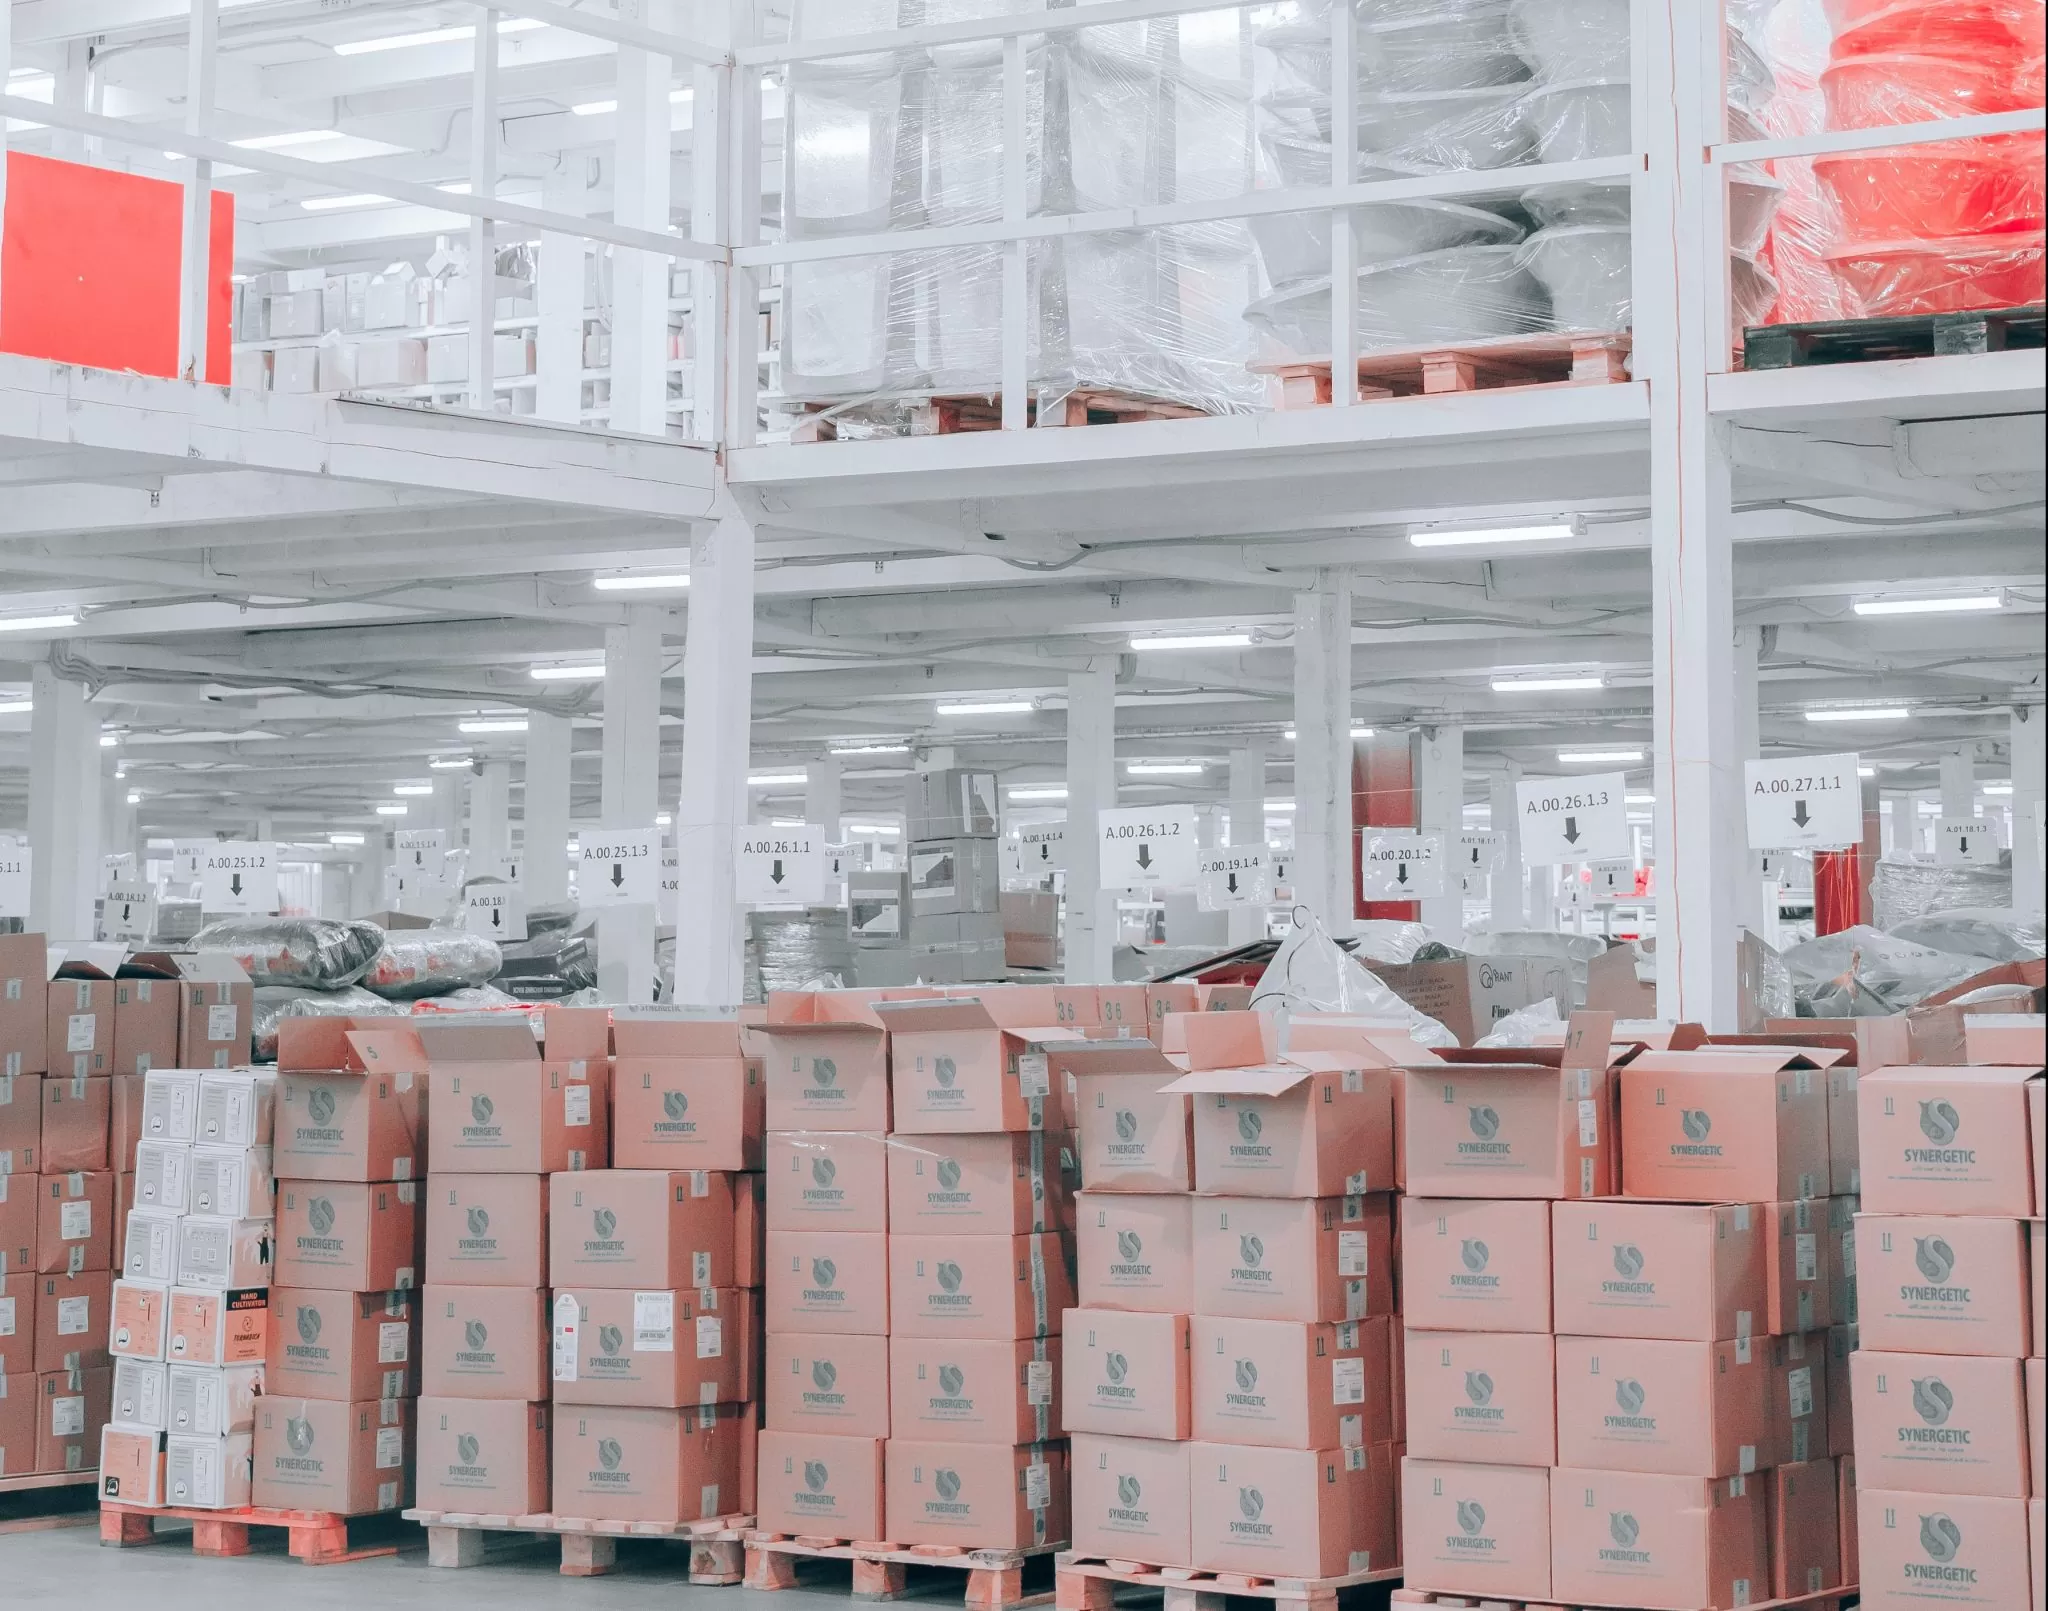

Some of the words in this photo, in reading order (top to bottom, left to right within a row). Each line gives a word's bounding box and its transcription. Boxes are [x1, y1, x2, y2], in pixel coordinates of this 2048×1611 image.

[1754, 776, 1841, 794] A.00.27.1.1
[1527, 791, 1608, 814] A.00.26.1.3
[1106, 822, 1180, 839] A.00.26.1.2
[1023, 831, 1063, 844] A.00.14.1.4
[584, 845, 648, 860] A.00.25.1.3
[744, 841, 810, 853] A.00.26.1.1
[1369, 849, 1431, 861] A.00.20.1.2
[208, 857, 265, 869] A.00.25.1.2
[1201, 857, 1258, 873] A.00.19.1.4
[803, 1089, 846, 1099] SYNERGETIC
[927, 1090, 965, 1099] SYNERGETIC
[462, 1127, 502, 1137] SYNERGETIC
[653, 1122, 697, 1132] SYNERGETIC
[296, 1128, 344, 1141] SYNERGETIC
[1107, 1144, 1145, 1154] SYNERGETIC
[1230, 1146, 1272, 1156] SYNERGETIC
[1458, 1143, 1511, 1154] SYNERGETIC
[1670, 1145, 1723, 1156] SYNERGETIC
[1904, 1149, 1976, 1163] SYNERGETIC
[802, 1191, 845, 1200] SYNERGETIC
[927, 1193, 971, 1203] SYNERGETIC
[297, 1237, 344, 1251] SYNERGETIC
[458, 1239, 497, 1249] SYNERGETIC
[584, 1241, 624, 1251] SYNERGETIC
[1110, 1264, 1152, 1275] SYNERGETIC
[1231, 1269, 1272, 1281] SYNERGETIC
[1450, 1275, 1500, 1287] SYNERGETIC
[1602, 1281, 1655, 1294] SYNERGETIC
[241, 1292, 258, 1300] HAND
[803, 1290, 845, 1301] SYNERGETIC
[928, 1295, 972, 1305] SYNERGETIC
[1900, 1286, 1971, 1302] SYNERGETIC
[286, 1345, 329, 1359] SYNERGETIC
[456, 1352, 495, 1362] SYNERGETIC
[589, 1358, 631, 1368] SYNERGETIC
[1097, 1385, 1136, 1398] SYNERGETIC
[803, 1393, 845, 1404] SYNERGETIC
[929, 1399, 973, 1409] SYNERGETIC
[1226, 1393, 1266, 1406] SYNERGETIC
[1454, 1407, 1504, 1420] SYNERGETIC
[1604, 1416, 1656, 1429] SYNERGETIC
[1898, 1428, 1971, 1444] SYNERGETIC
[275, 1457, 324, 1472] SYNERGETIC
[448, 1465, 487, 1477] SYNERGETIC
[588, 1472, 631, 1482] SYNERGETIC
[794, 1493, 836, 1506] SYNERGETIC
[925, 1503, 970, 1514] SYNERGETIC
[1108, 1508, 1148, 1522] SYNERGETIC
[1230, 1522, 1273, 1535] SYNERGETIC
[1446, 1537, 1496, 1549] SYNERGETIC
[1599, 1550, 1651, 1563] SYNERGETIC
[1903, 1563, 1977, 1583] SYNERGETIC
